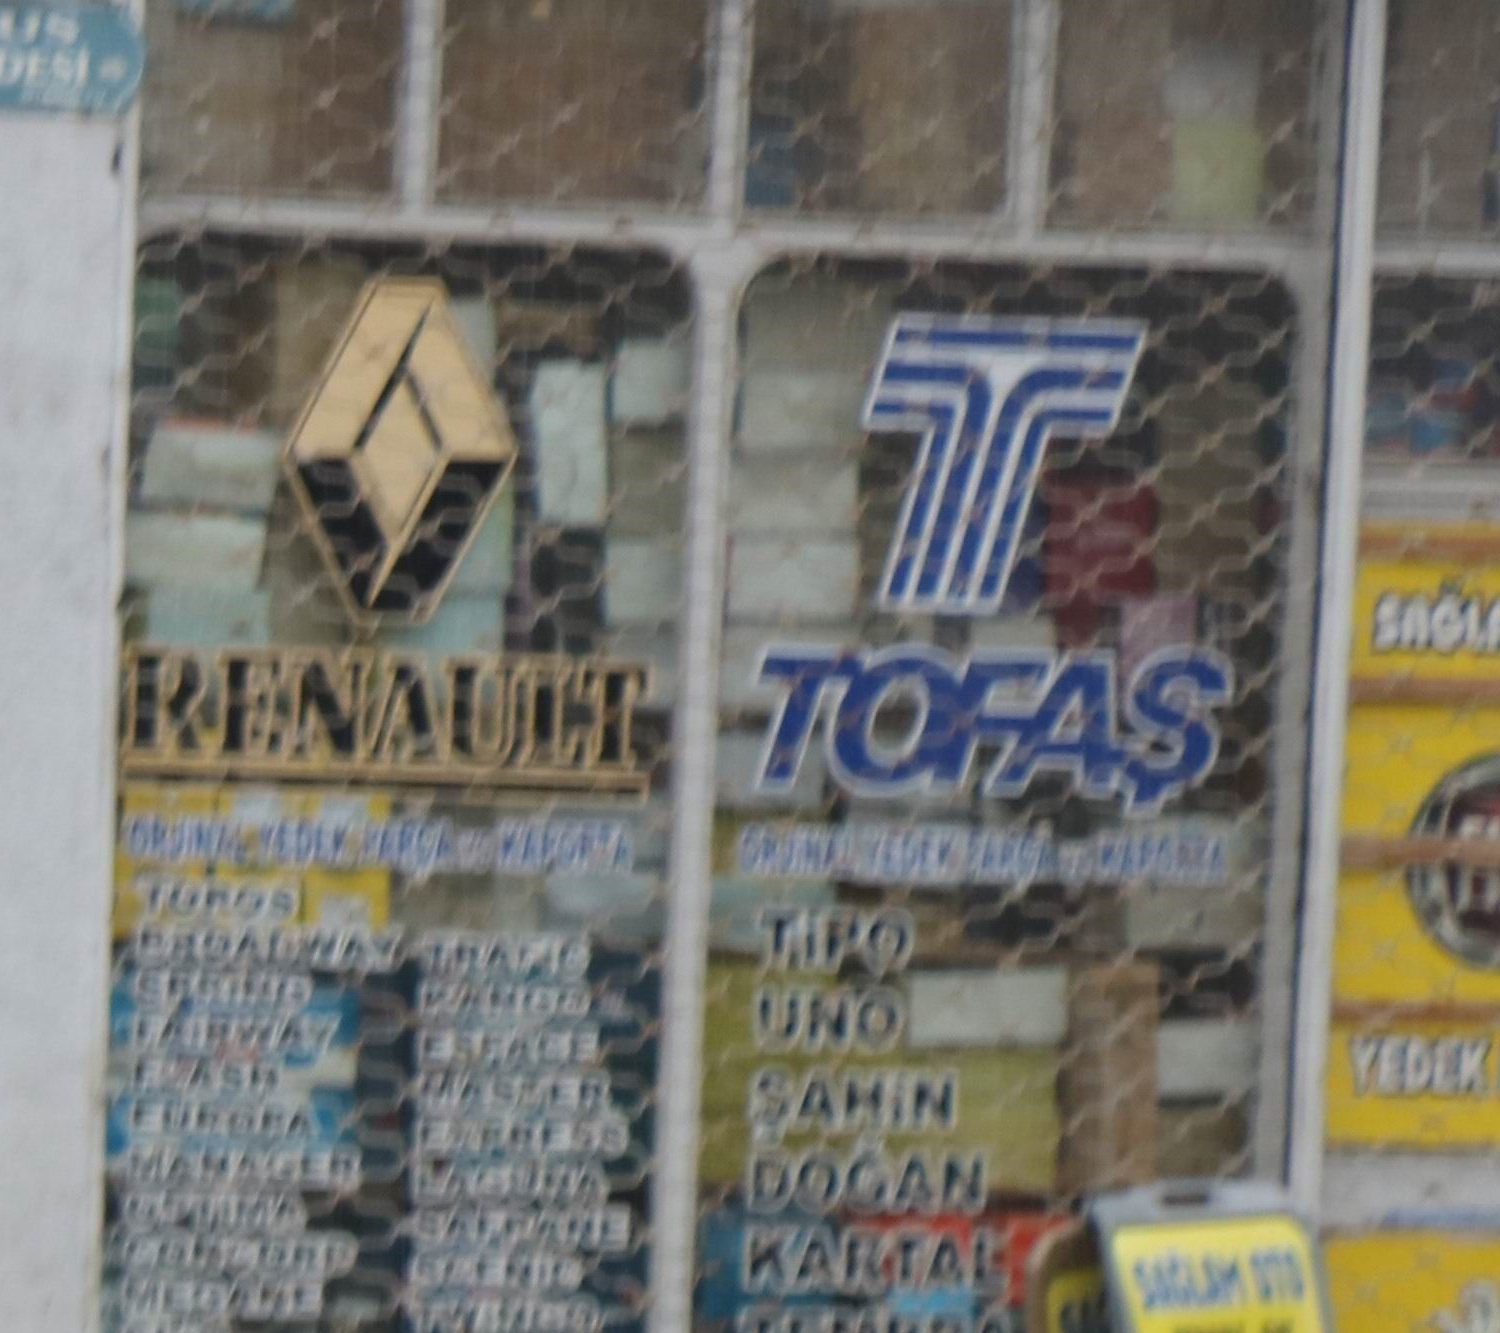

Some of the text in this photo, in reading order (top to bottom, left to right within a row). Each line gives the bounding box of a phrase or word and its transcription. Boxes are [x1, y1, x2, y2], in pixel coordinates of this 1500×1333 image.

[121, 646, 652, 768] RENAULT
[756, 643, 1235, 815] TOFAŞ
[136, 925, 403, 972] BROADWAY
[417, 1025, 599, 1066] ESPACE
[752, 981, 906, 1053] UNO
[416, 1070, 610, 1113] MASTER
[1349, 1034, 1494, 1096] YEDEK
[414, 1116, 630, 1160] EXPRESS
[127, 1147, 361, 1192] MANAGER
[746, 1130, 989, 1214] DOĞAN
[742, 1220, 1012, 1295] KARTAL
